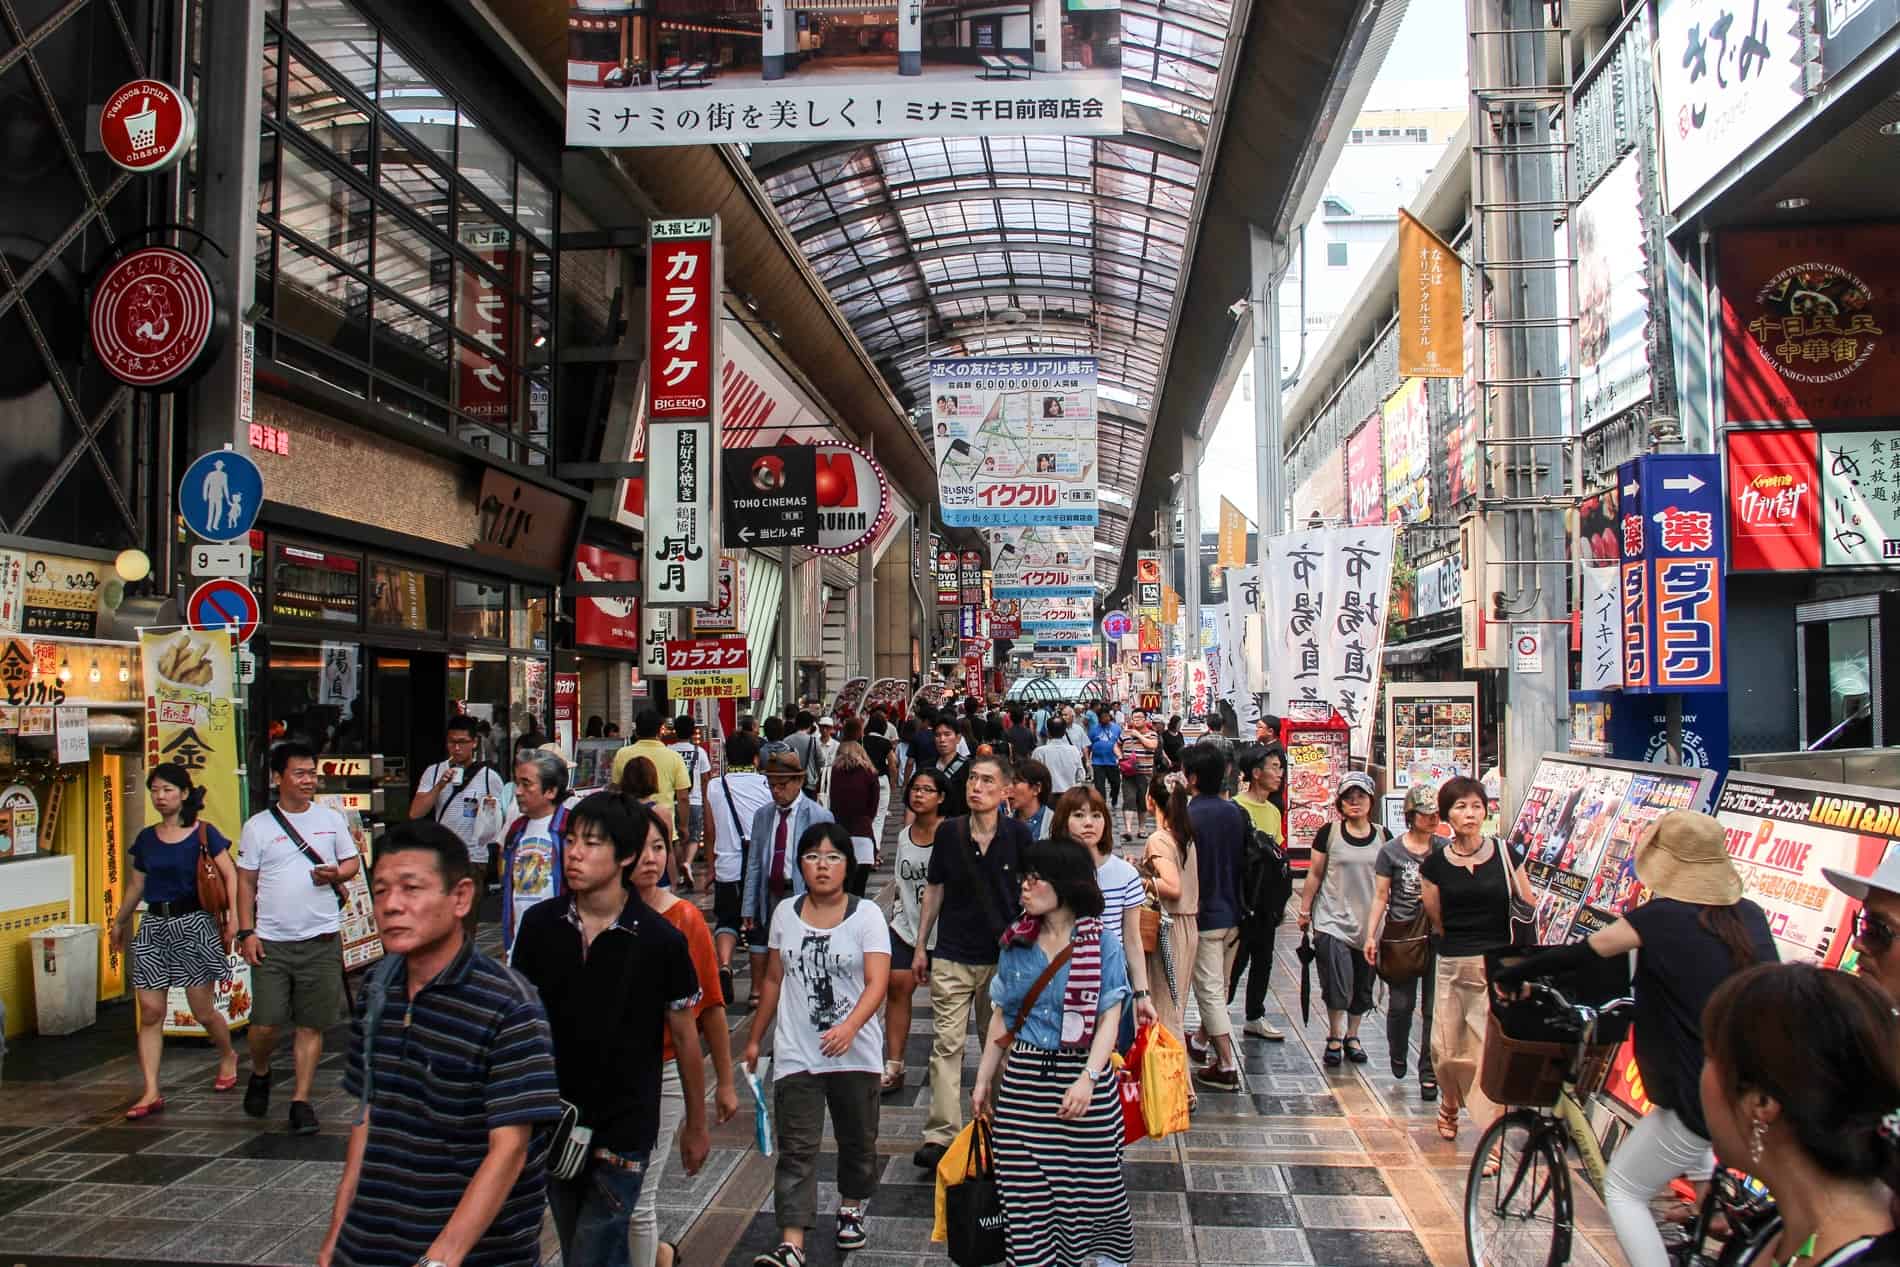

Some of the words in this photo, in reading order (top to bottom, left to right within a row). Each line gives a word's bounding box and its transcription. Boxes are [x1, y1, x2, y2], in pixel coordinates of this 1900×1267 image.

[106, 87, 140, 119] Tapioca
[142, 85, 169, 104] Drink
[586, 97, 882, 133] ミナミの街を美しく！
[905, 98, 1103, 121] ミナミ千日前商店会
[654, 221, 710, 236] 丸福ビル
[662, 251, 698, 387] カラオケ
[932, 361, 1094, 377] 近くの友だちをリアル表示
[679, 432, 694, 501] お好み焼き
[1870, 438, 1888, 501] 食べ放題
[733, 499, 760, 509] TOHO
[762, 497, 807, 507] CINEMAS
[978, 484, 1057, 506] イククル
[760, 528, 788, 539] 当ビル
[790, 527, 805, 538] 4F
[1623, 514, 1643, 557] 薬
[1663, 510, 1713, 552] 薬
[656, 535, 703, 592] 風月
[938, 572, 957, 580] DVD
[1020, 570, 1069, 585] イククル
[1103, 619, 1132, 631] 123
[1594, 586, 1617, 681] バイキング
[1625, 566, 1646, 682] ダイコク
[1663, 563, 1713, 680] ダイコク
[670, 648, 744, 666] カラオケ
[8, 678, 66, 705] とりから
[1766, 838, 1813, 871] ZONE
